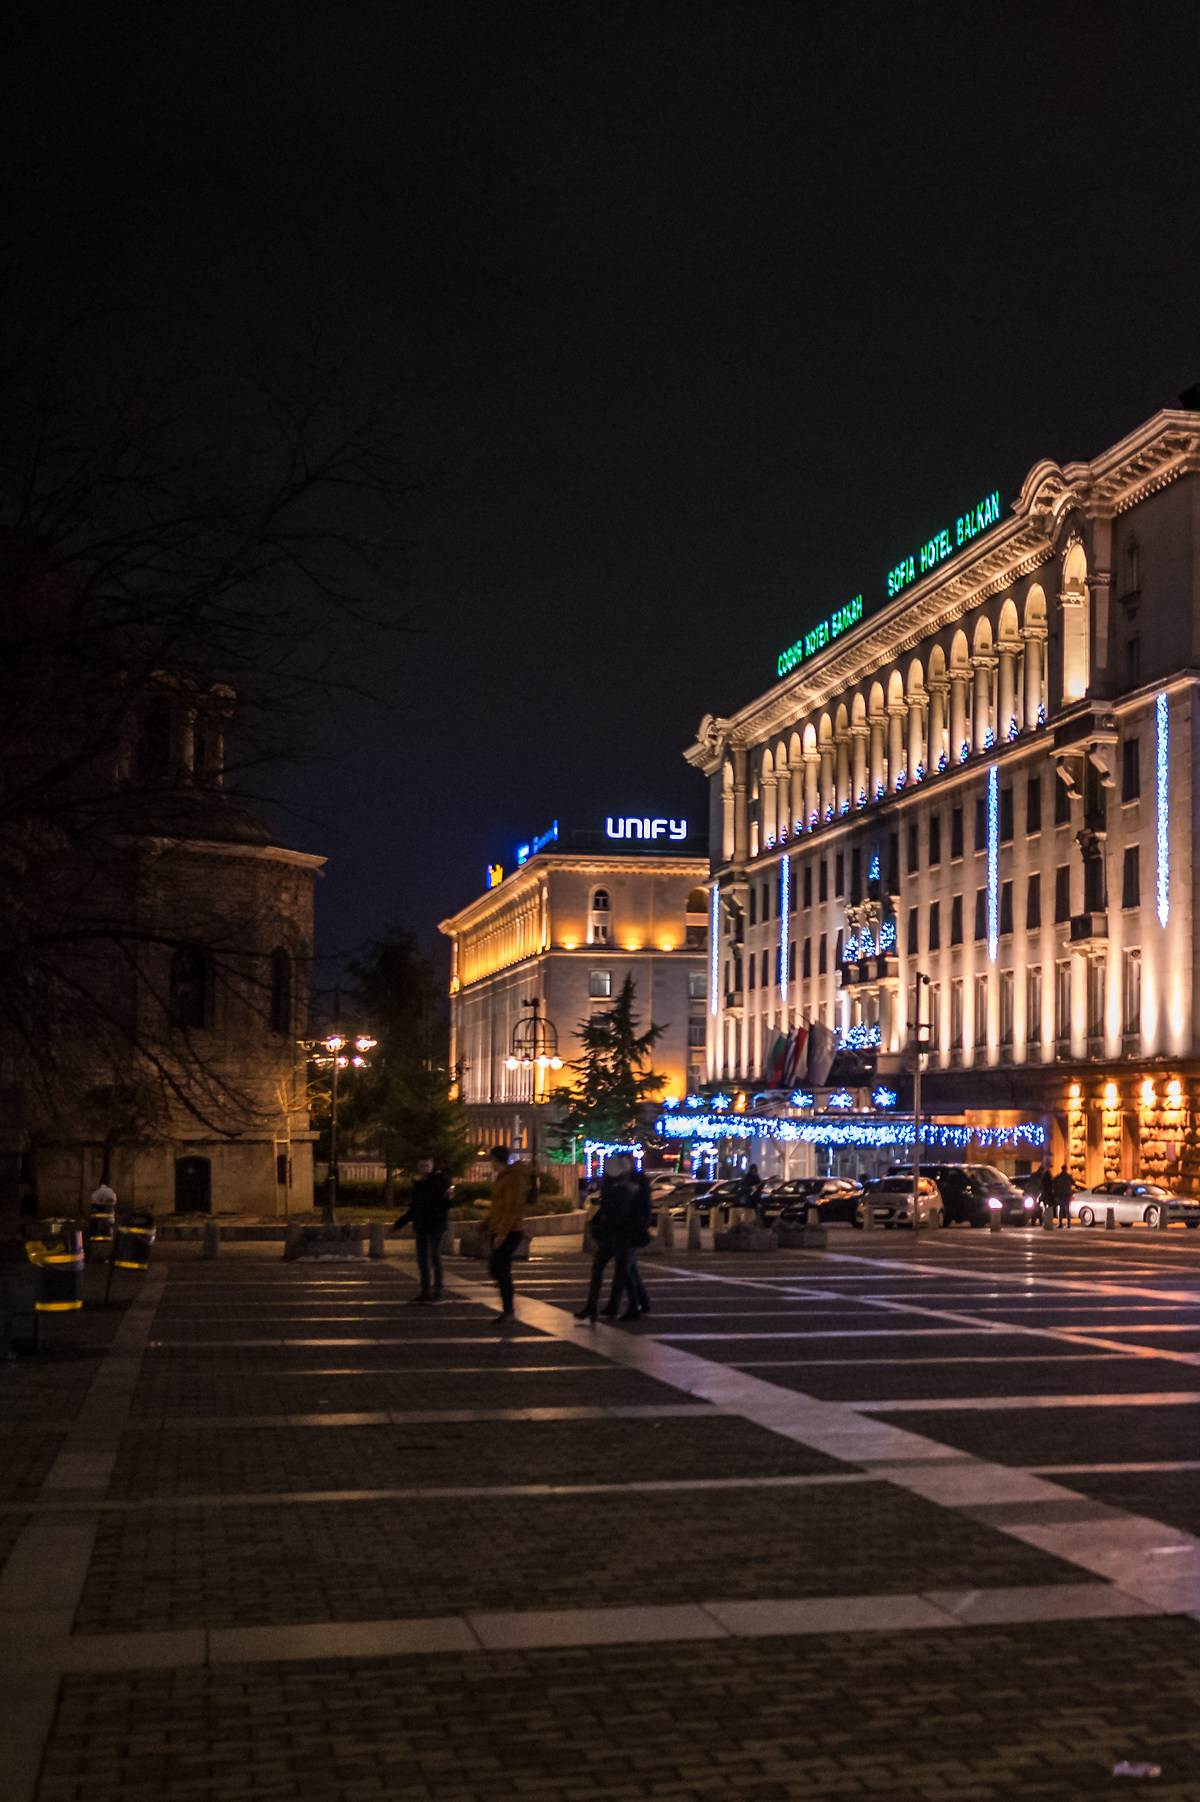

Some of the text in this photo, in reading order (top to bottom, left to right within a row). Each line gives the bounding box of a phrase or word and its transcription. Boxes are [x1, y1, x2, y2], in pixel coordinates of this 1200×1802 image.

[887, 490, 1000, 597] SOFIA HOTEL BALKAN
[605, 816, 688, 841] UNIFY
